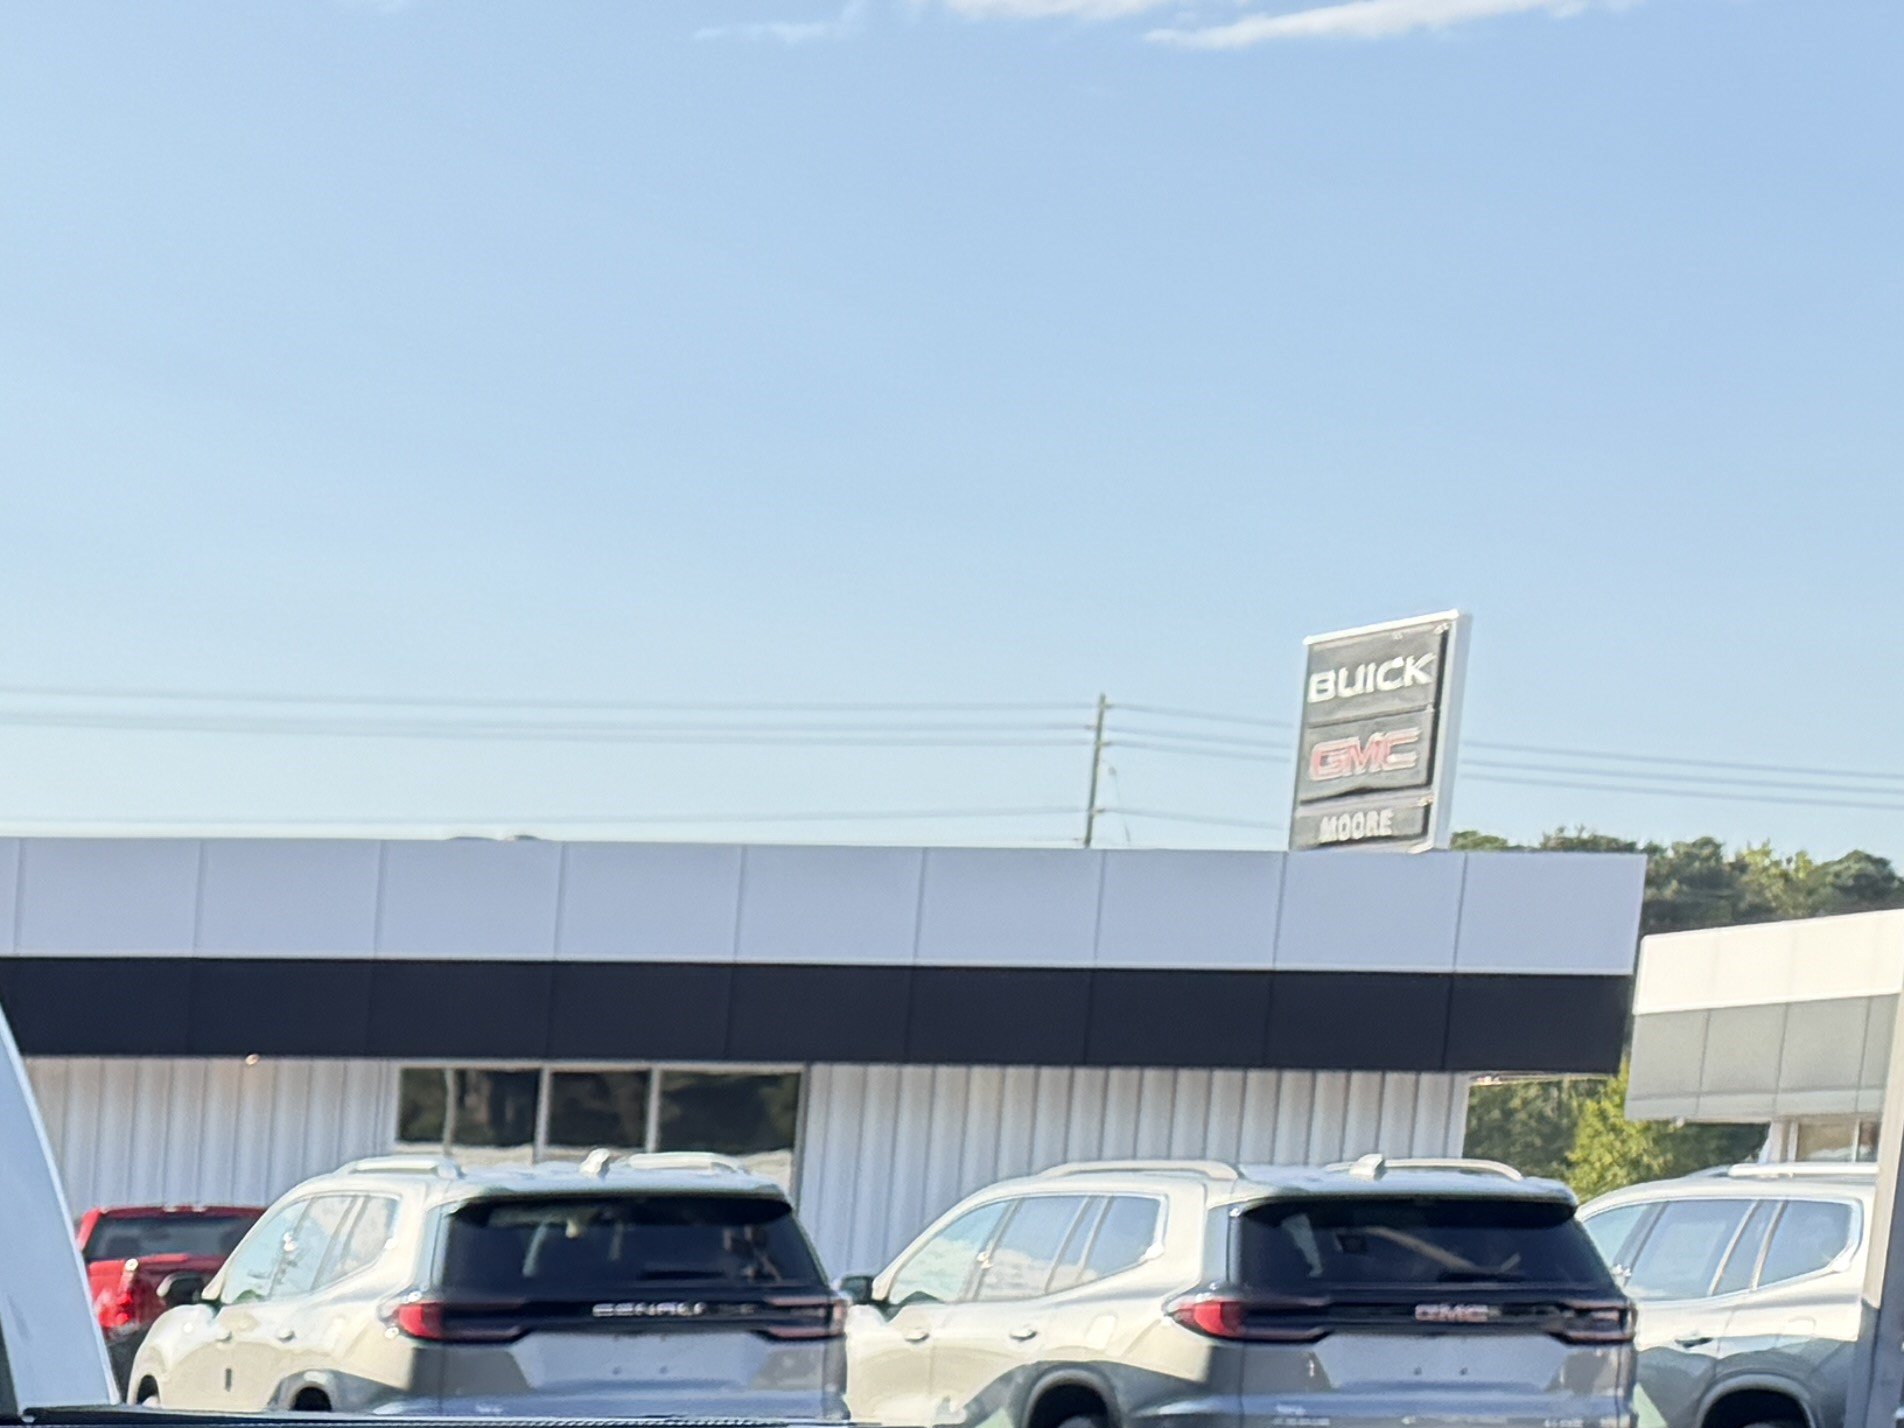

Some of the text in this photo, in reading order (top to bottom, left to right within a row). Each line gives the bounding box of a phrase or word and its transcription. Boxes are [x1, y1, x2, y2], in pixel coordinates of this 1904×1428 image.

[1308, 653, 1435, 703] BUICK
[1310, 728, 1420, 781] GMC
[1318, 809, 1394, 843] MOORE
